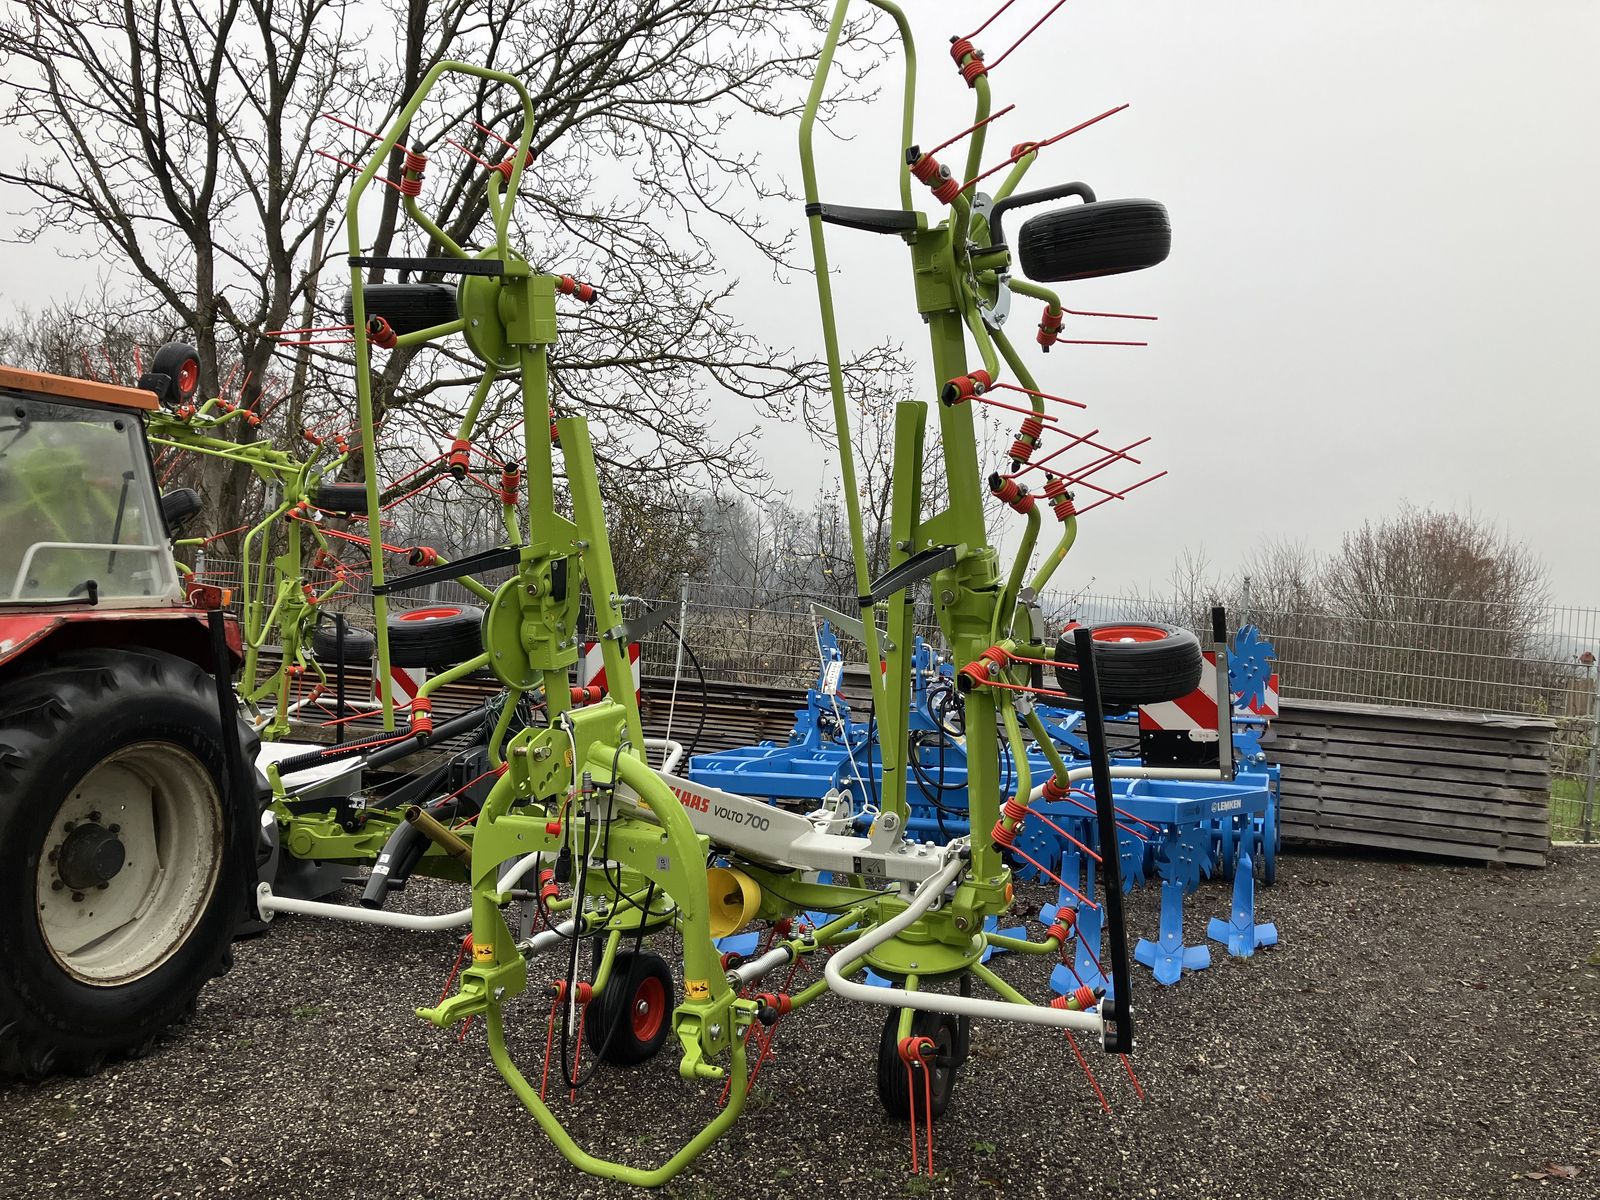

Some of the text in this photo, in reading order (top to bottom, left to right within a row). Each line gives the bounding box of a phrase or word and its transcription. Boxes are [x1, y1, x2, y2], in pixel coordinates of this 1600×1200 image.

[1217, 799, 1242, 811] LEMKEN
[714, 805, 770, 832] VOLTO 700
